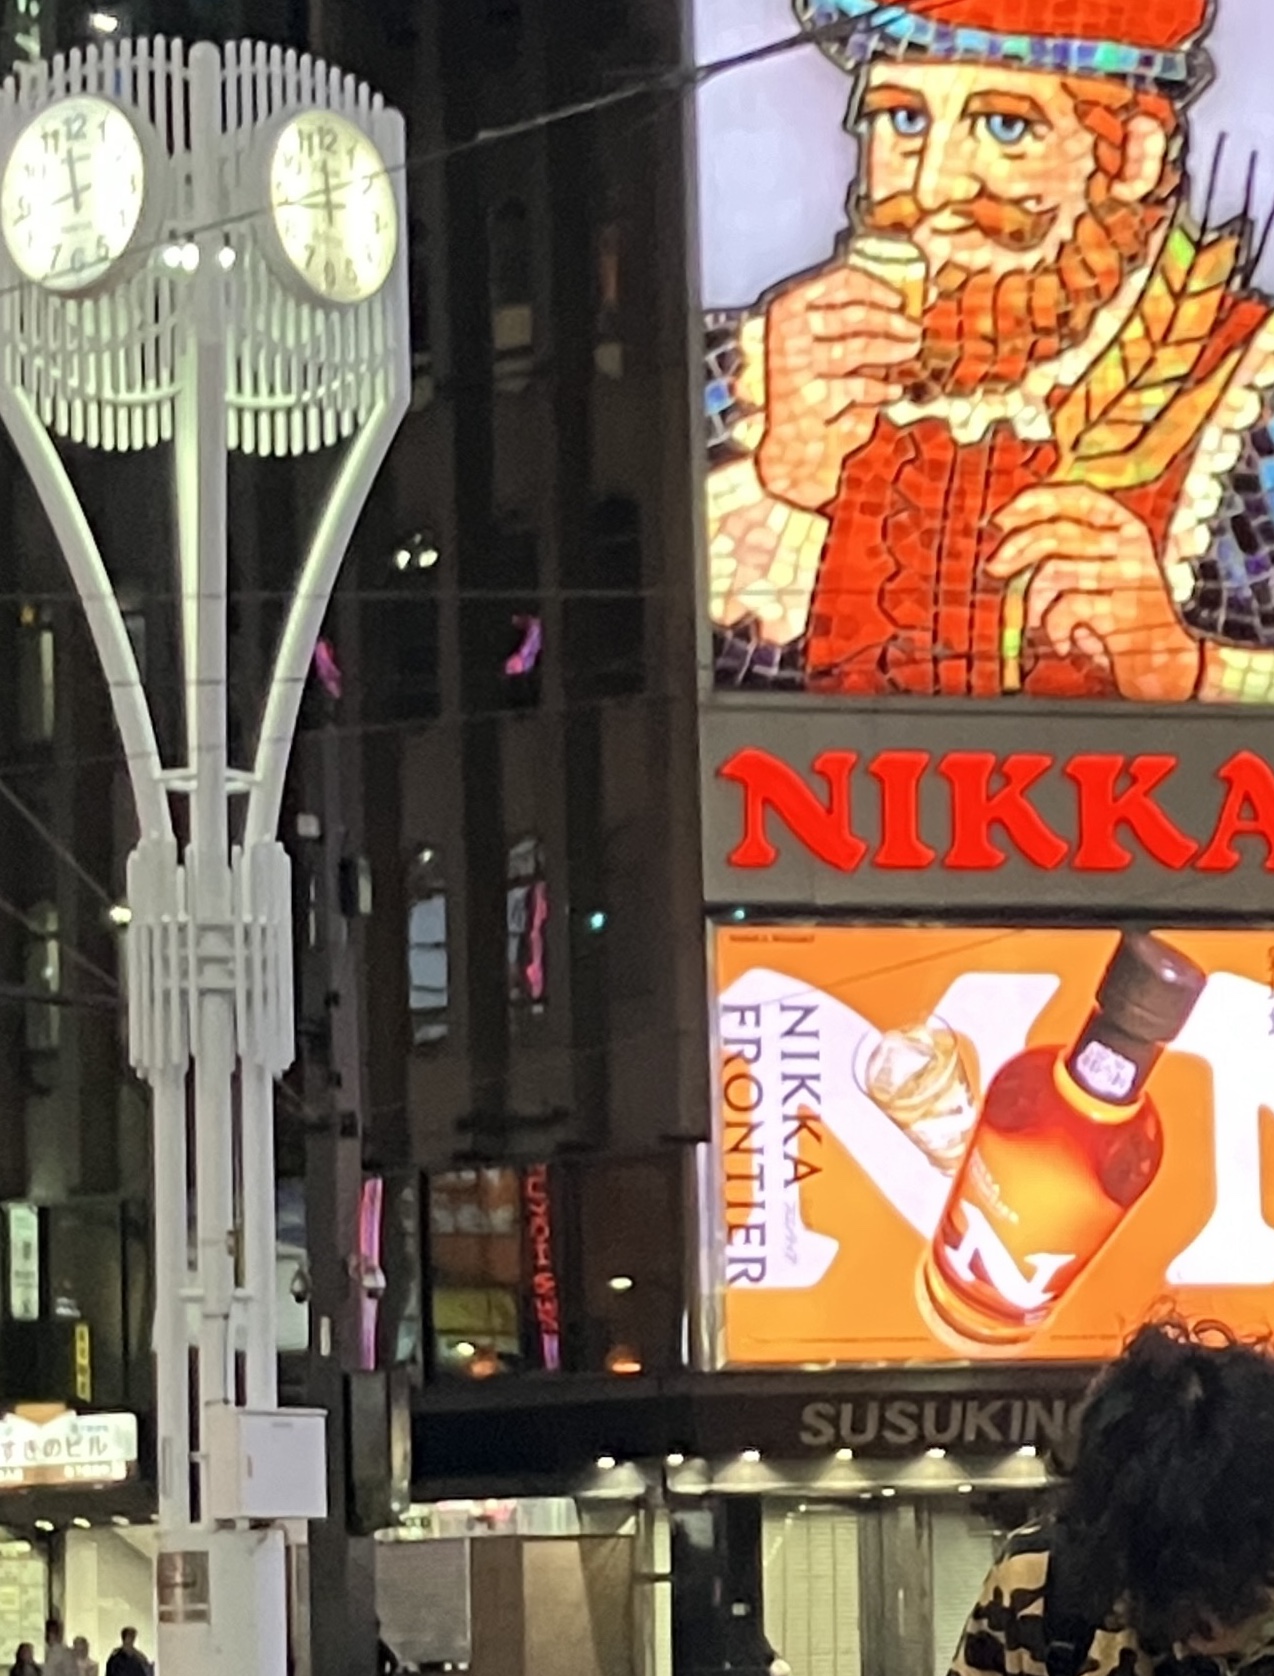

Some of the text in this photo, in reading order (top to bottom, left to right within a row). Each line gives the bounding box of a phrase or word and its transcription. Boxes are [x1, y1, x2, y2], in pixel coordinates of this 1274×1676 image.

[64, 113, 87, 142] 12
[721, 1003, 767, 1287] FRONTIER
[779, 1002, 823, 1190] NIKKA
